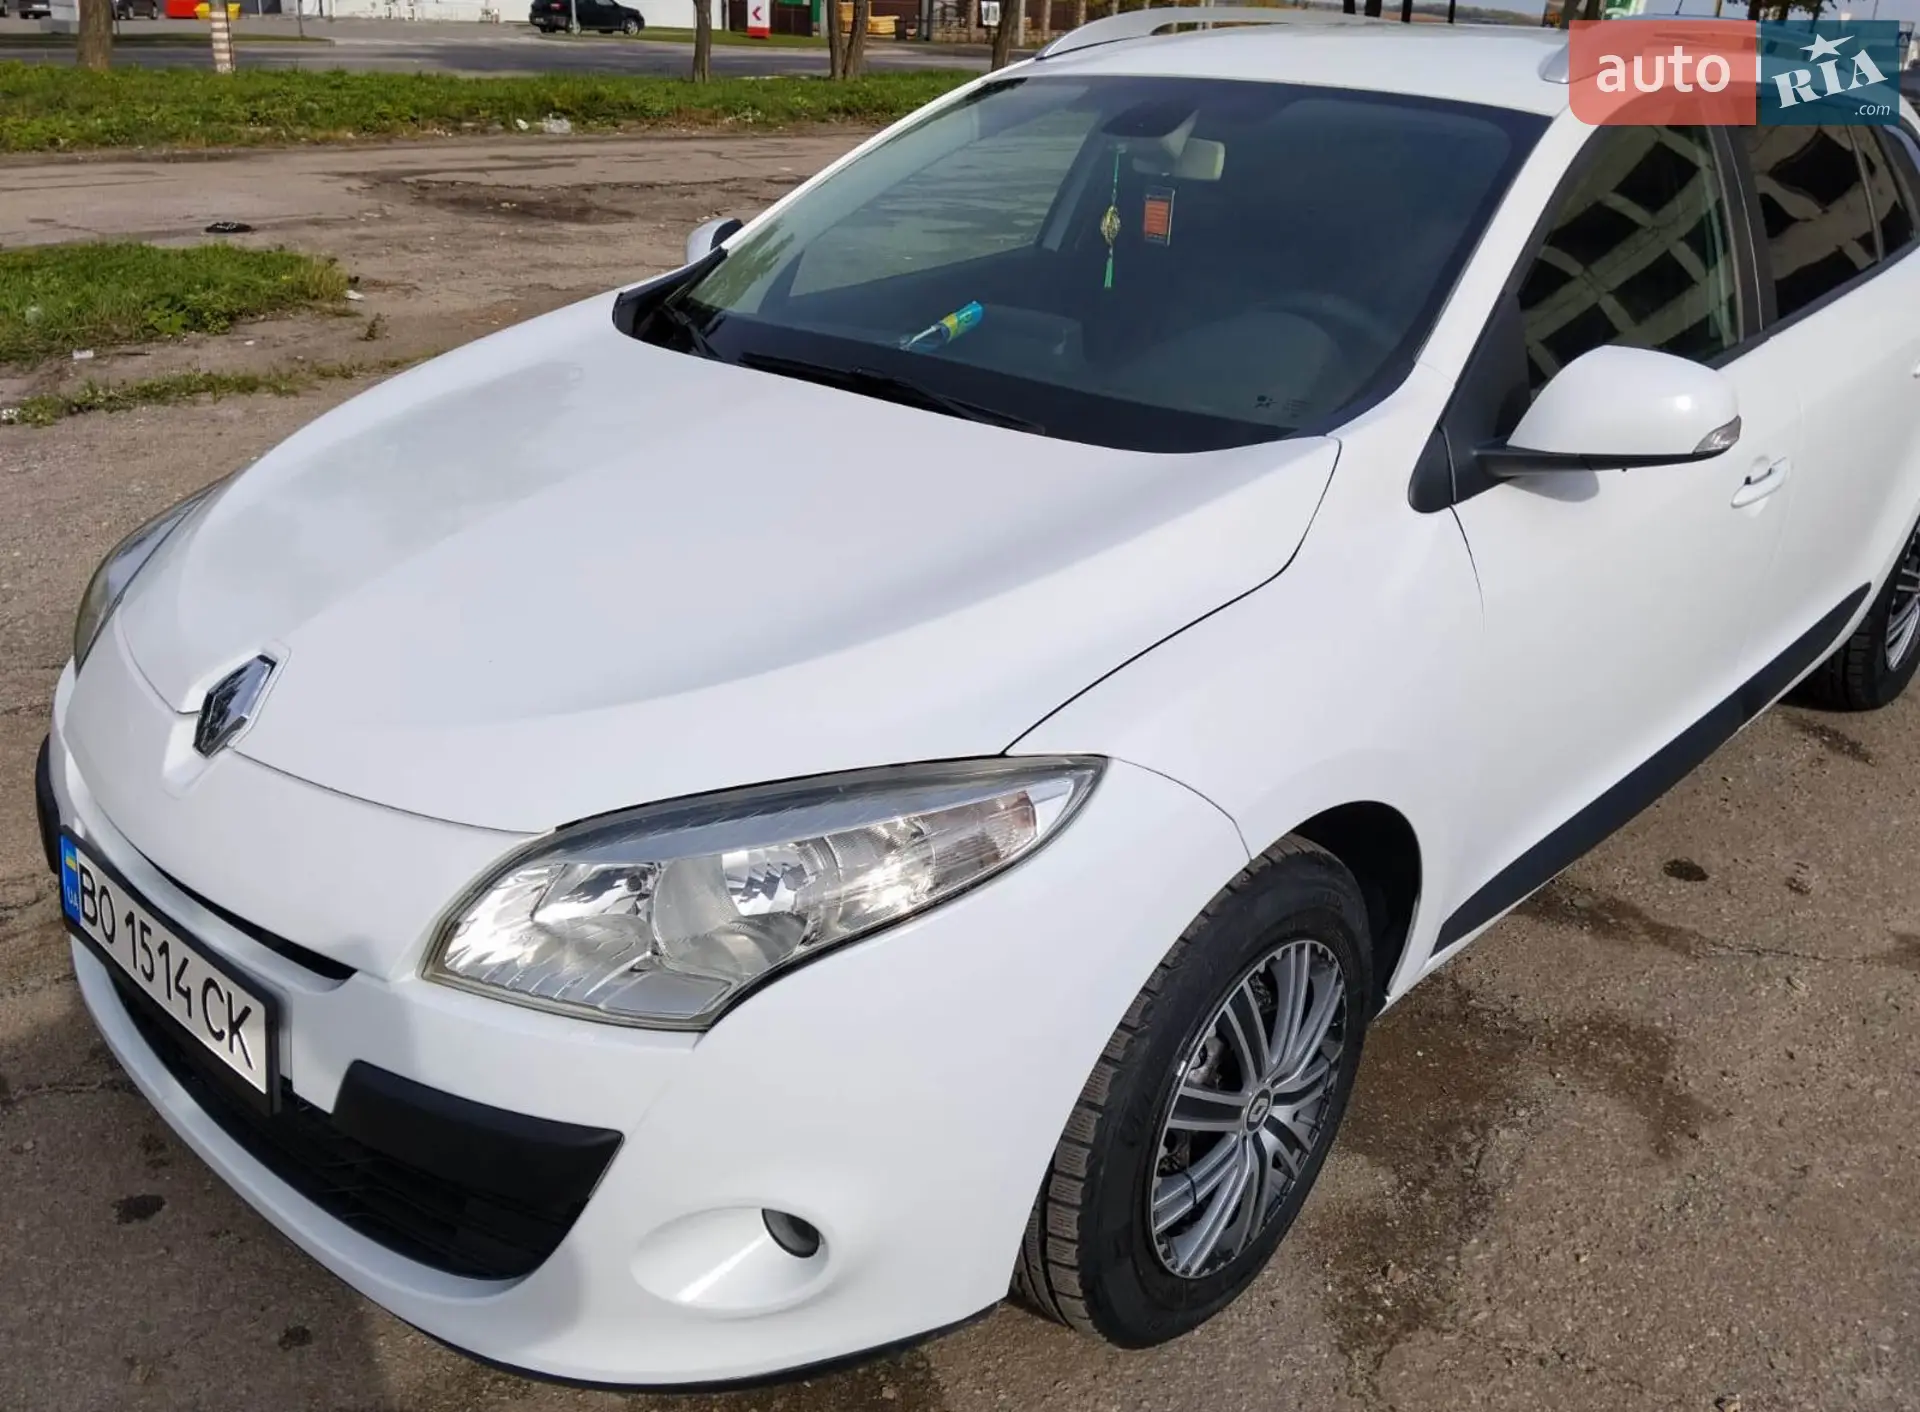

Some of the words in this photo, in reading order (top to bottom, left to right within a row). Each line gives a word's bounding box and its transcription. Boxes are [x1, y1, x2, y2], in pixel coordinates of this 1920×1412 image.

[79, 864, 116, 945] BO
[124, 910, 193, 1019] 1514
[201, 977, 253, 1071] CK
